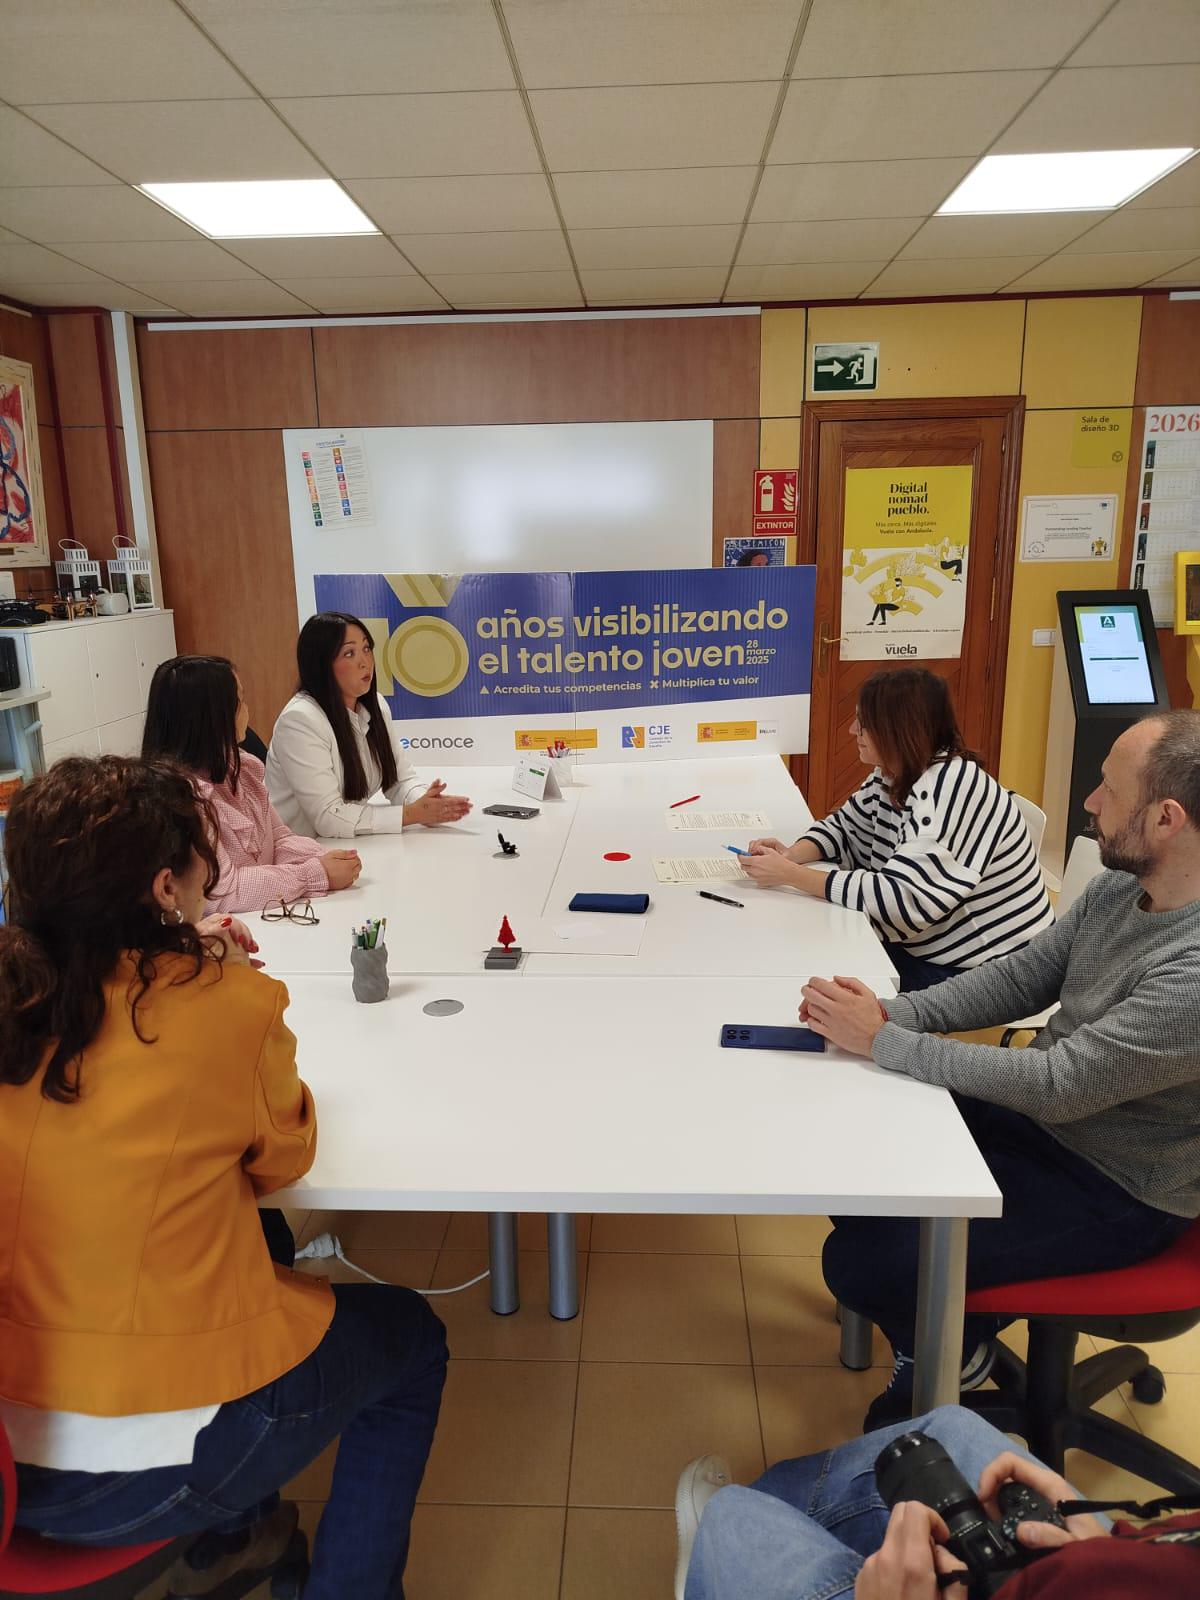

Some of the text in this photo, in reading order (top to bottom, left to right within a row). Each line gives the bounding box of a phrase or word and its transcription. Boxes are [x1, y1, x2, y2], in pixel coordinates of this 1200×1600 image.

[1081, 415, 1110, 424] Sala de
[1148, 413, 1200, 433] 2026
[1108, 424, 1120, 432] 3D
[890, 481, 928, 495] Digital
[888, 493, 928, 504] nomad
[887, 504, 930, 518] pueblo.
[756, 521, 794, 530] EXTINTOR
[476, 600, 789, 639] años visibilizando
[746, 639, 759, 649] 28
[885, 643, 918, 655] vuela
[746, 647, 777, 656] marzo
[478, 640, 745, 676] el talento joven
[746, 655, 770, 665] 2025
[493, 674, 760, 695] Acredita tus competencias Multiplica tu valor
[648, 725, 671, 736] CJE
[399, 737, 474, 750] econoce
